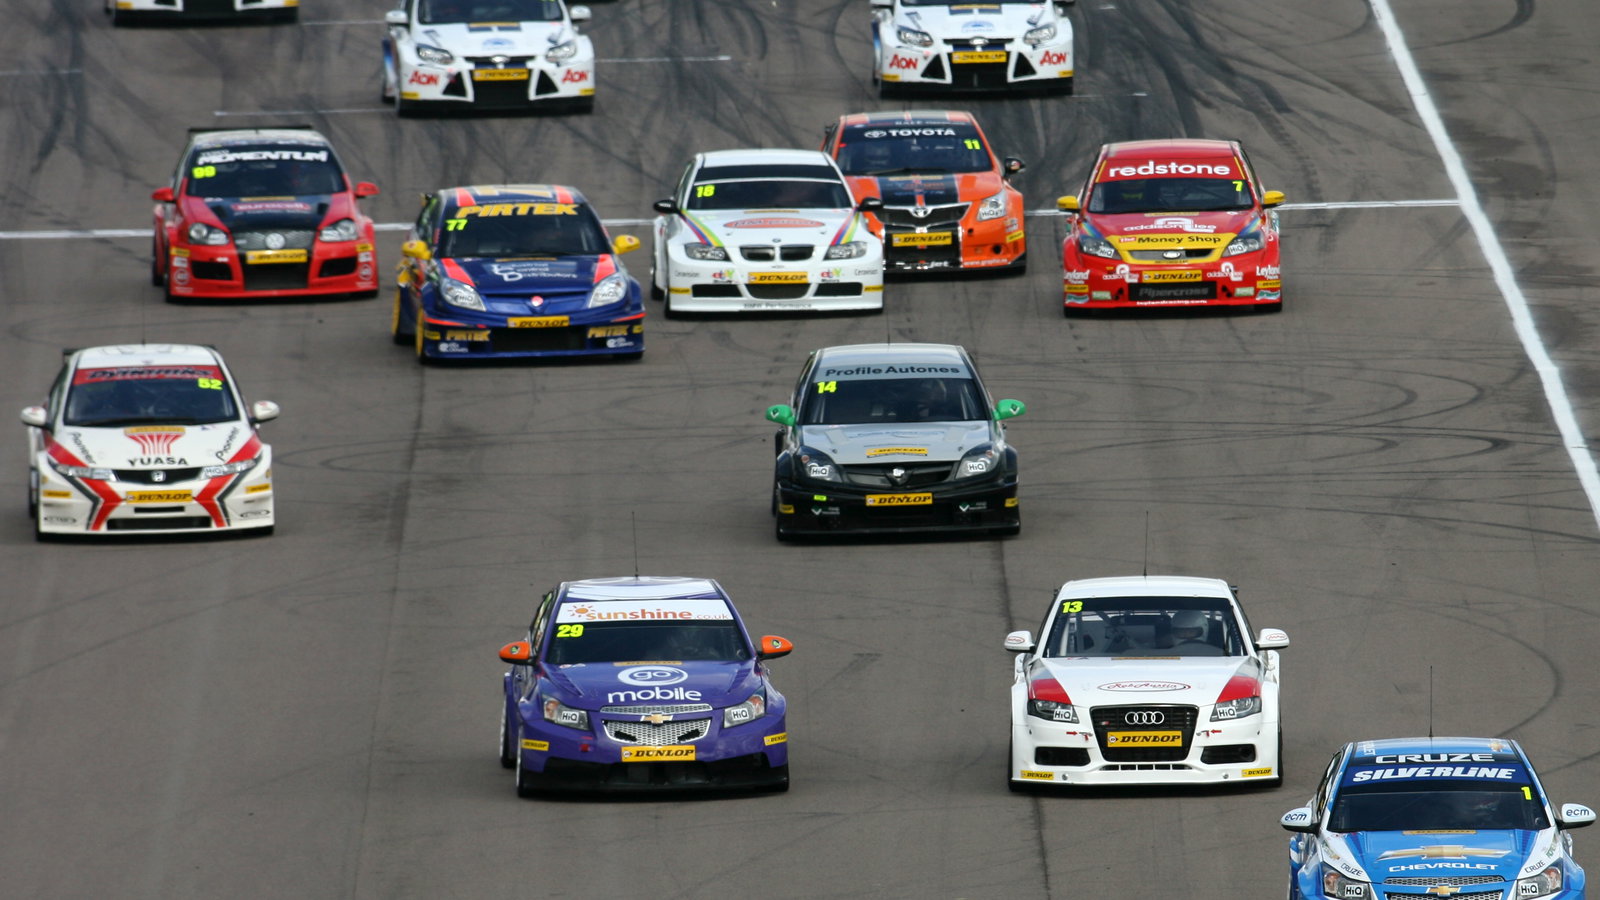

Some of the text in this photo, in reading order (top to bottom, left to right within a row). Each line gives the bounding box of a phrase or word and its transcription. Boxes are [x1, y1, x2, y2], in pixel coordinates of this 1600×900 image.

[889, 128, 956, 137] TOYOTA
[963, 139, 981, 150] 11
[197, 150, 328, 166] MOMENTUM
[1108, 160, 1231, 178] redstone
[695, 184, 716, 198] 18
[1232, 180, 1244, 192] 7
[455, 202, 580, 219] PIRTEK
[446, 218, 469, 231] 77
[904, 234, 952, 244] DUNLOP
[1137, 235, 1186, 245] Money
[1187, 234, 1222, 244] Shop
[758, 274, 808, 282] DUNLOP
[1151, 272, 1202, 281] DUNLOP
[518, 319, 569, 328] DUNLOP
[446, 330, 492, 342] PIRTEK
[587, 324, 631, 339] PIRTEK
[825, 366, 883, 377] Profile
[197, 377, 223, 391] 52
[816, 380, 838, 394] 14
[127, 456, 190, 467] YUASA
[968, 462, 985, 471] HiQ
[811, 468, 829, 476] HiQ
[137, 493, 192, 502] DUNLOP
[878, 495, 931, 504] DUNLOP
[1061, 600, 1083, 614] 13
[556, 624, 585, 638] 29
[634, 670, 671, 681] go
[608, 686, 702, 703] mobile
[562, 711, 578, 722] HiQ
[732, 709, 749, 720] HiQ
[1054, 709, 1072, 720] HiQ
[1218, 707, 1236, 718] HiQ
[1120, 734, 1181, 743] DUNLOP
[523, 741, 549, 749] DUNLOP
[634, 748, 696, 758] DUNLOP
[1375, 753, 1496, 765] CRUZE
[1026, 771, 1053, 779] DUNLOP
[1247, 768, 1273, 777] DUNLOP
[1521, 786, 1533, 801] 1
[1284, 812, 1308, 823] ecm
[1566, 808, 1590, 817] ecm
[1340, 862, 1364, 877] CRUZE
[1388, 862, 1500, 873] CHEVROLET
[1524, 860, 1546, 874] CRUZE
[1345, 886, 1363, 896] HiQ
[1520, 884, 1538, 895] HiQ
